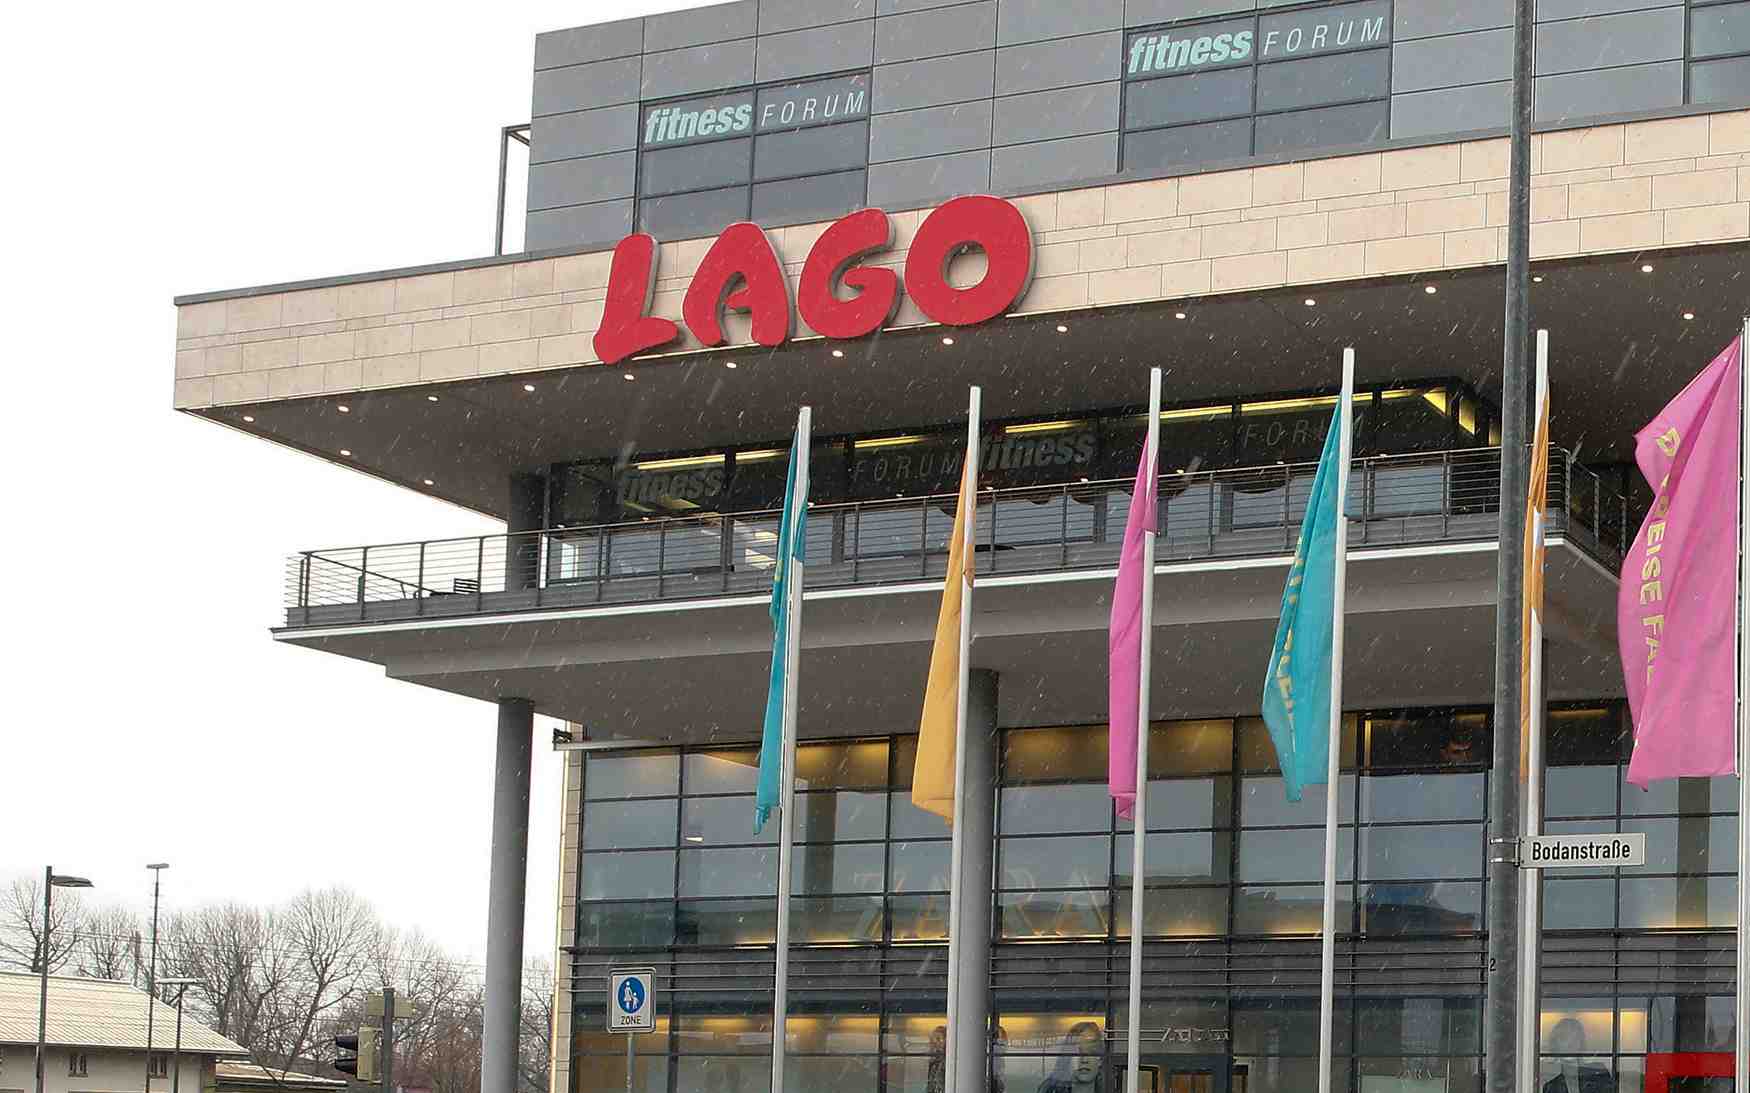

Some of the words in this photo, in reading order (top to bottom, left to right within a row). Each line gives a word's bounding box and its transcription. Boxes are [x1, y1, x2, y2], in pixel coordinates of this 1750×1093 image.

[1128, 27, 1253, 75] fitness
[1263, 15, 1384, 55] FORUM
[645, 101, 752, 144] fitness
[760, 91, 866, 128] FORUM
[592, 195, 1036, 365] LAGO
[1532, 840, 1630, 860] Bodanstraße
[620, 1015, 642, 1025] ZONE
